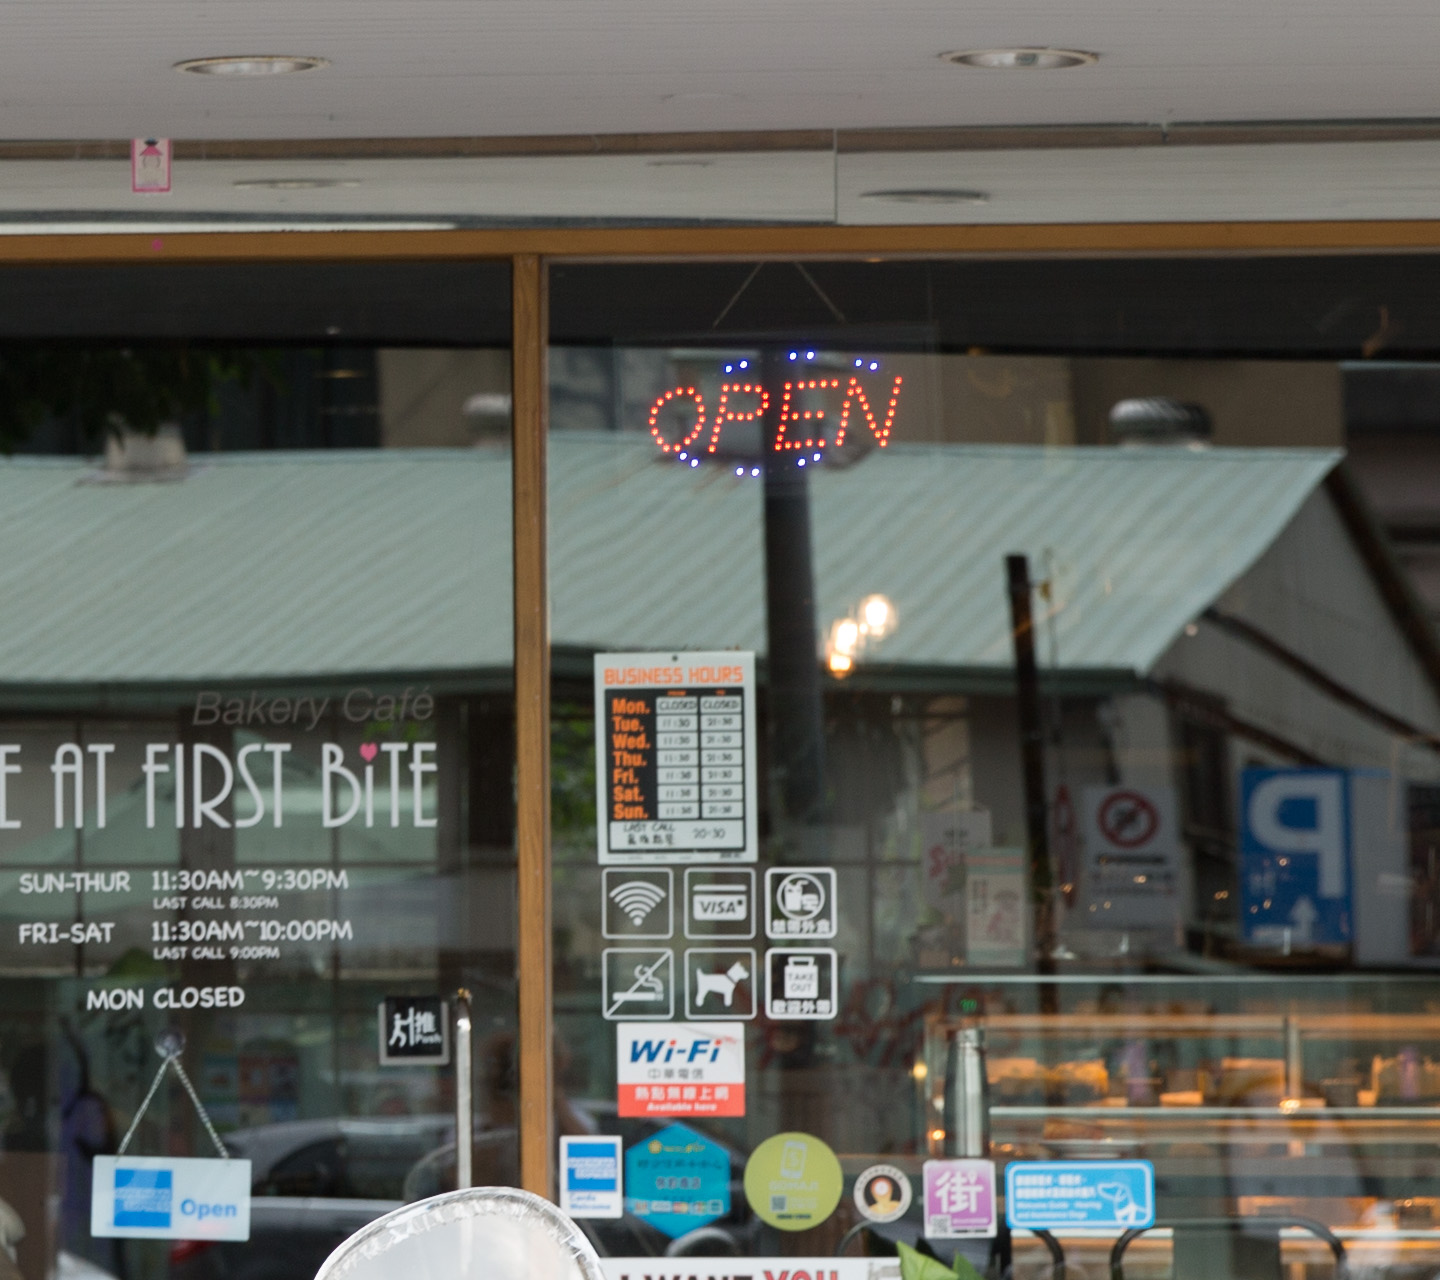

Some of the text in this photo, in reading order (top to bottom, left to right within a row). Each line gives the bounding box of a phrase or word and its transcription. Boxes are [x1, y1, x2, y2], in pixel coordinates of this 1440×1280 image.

[648, 375, 903, 453] OPEN
[603, 666, 744, 686] BUSINESS HOURS
[192, 684, 436, 732] Bakery Café
[611, 697, 739, 715] Mon. CLOSED CLOSED
[611, 716, 645, 732] Tue.
[611, 733, 651, 749] Wed.
[612, 751, 648, 767] Thu.
[612, 768, 639, 784] Fri.
[50, 743, 116, 831] AT
[141, 742, 293, 831] FIRST
[613, 785, 645, 802] Sat.
[613, 803, 649, 820] Sun.
[19, 871, 132, 894] SUN-THUR
[153, 896, 279, 910] LAST CALL 8:30PM
[699, 900, 736, 915] VISA
[19, 922, 116, 944] FRI-SAT
[153, 946, 280, 960] LAST CALL 9:00PM
[787, 971, 816, 982] TAKE
[789, 983, 813, 993] OUT
[86, 986, 246, 1011] MON CLOSED
[415, 1011, 436, 1034] 推
[629, 1038, 723, 1064] Wi-Fi
[647, 1068, 704, 1080] 中華電信
[934, 1170, 984, 1215] 街
[180, 1198, 238, 1220] Open
